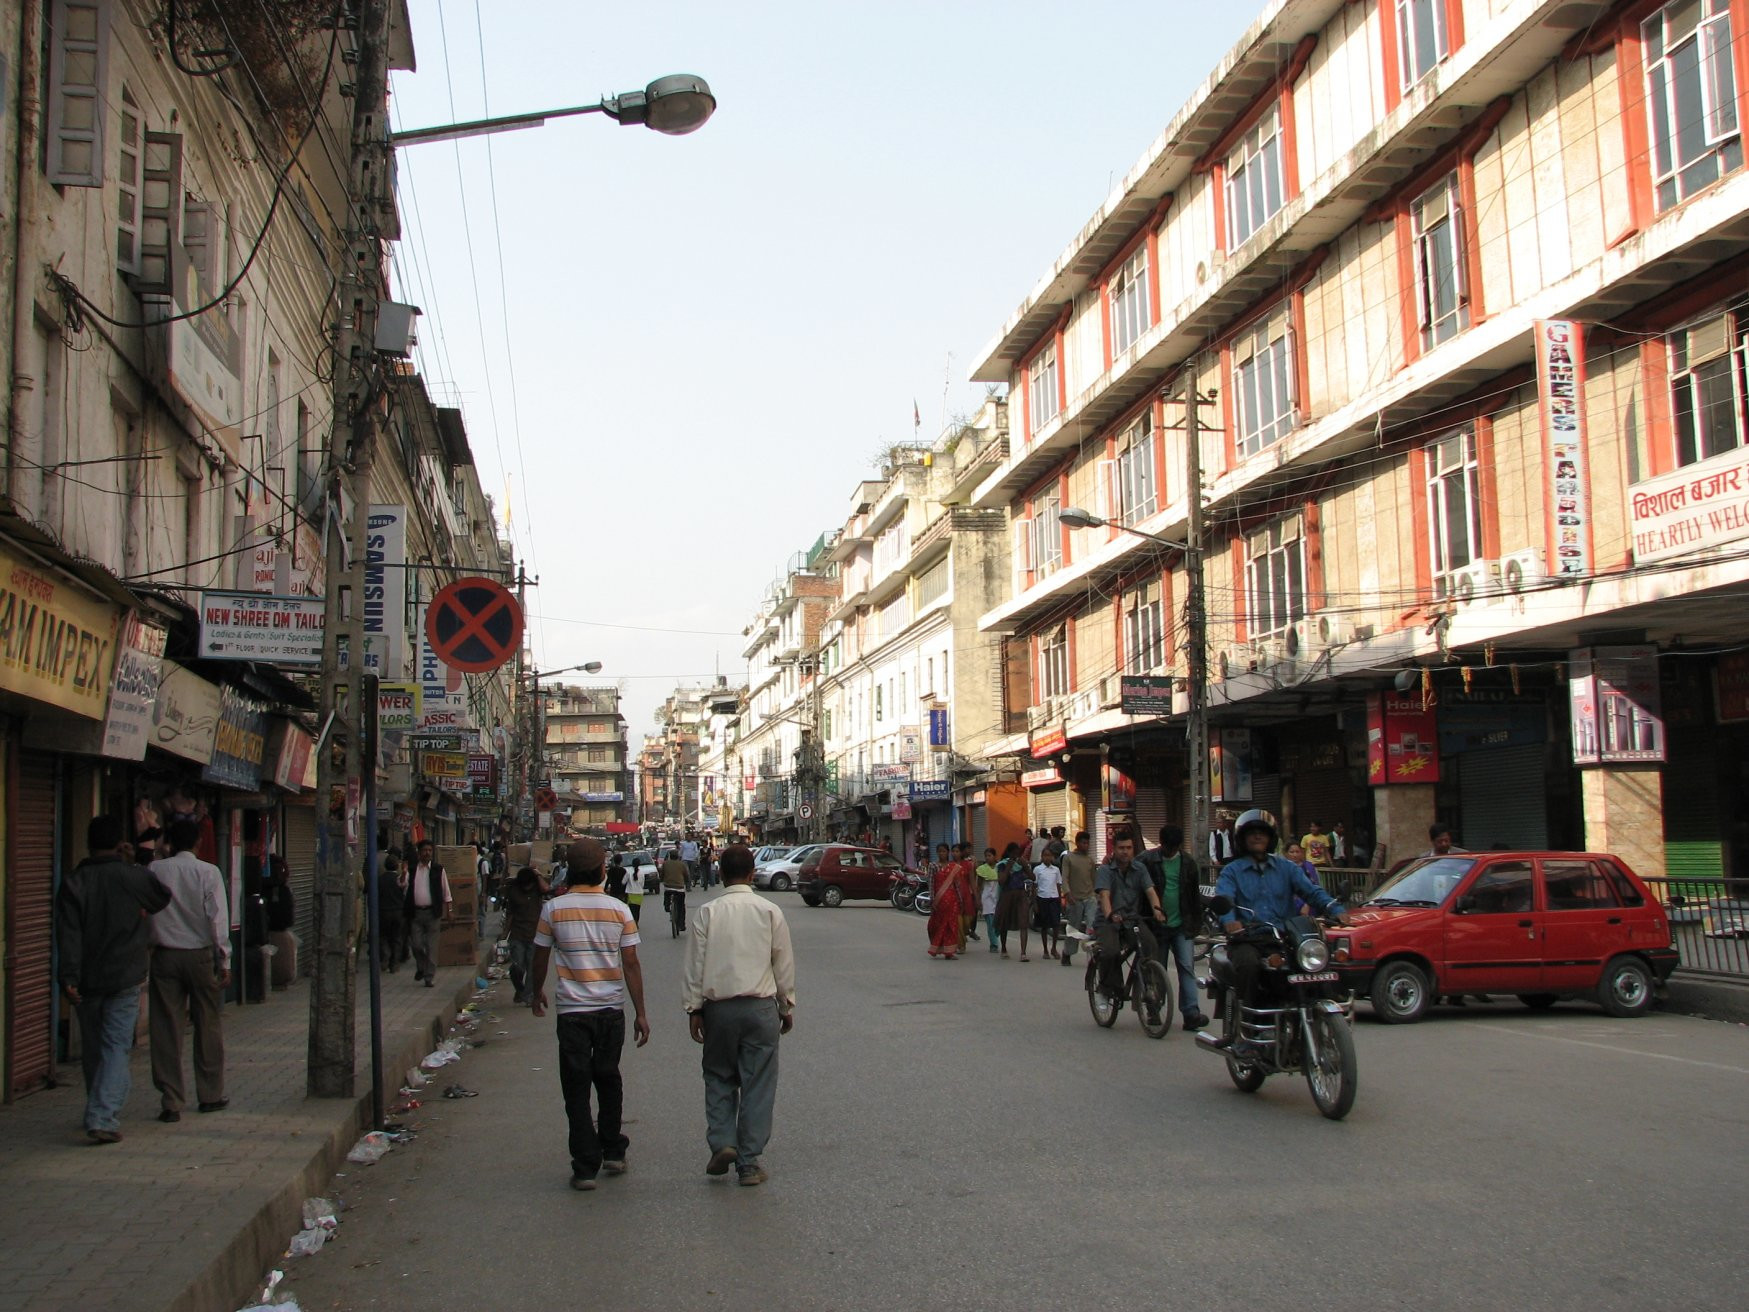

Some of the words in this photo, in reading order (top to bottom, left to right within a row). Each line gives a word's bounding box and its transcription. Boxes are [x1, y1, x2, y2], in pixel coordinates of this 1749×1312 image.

[1546, 324, 1576, 431] GAMERS
[1633, 485, 1686, 521] विशाल
[1690, 466, 1742, 501] बजार
[1636, 515, 1703, 556] HEARTLY
[206, 608, 230, 625] NEW
[233, 610, 270, 628] SHREE
[273, 611, 290, 629] OM
[244, 630, 265, 639] Gents
[36, 609, 108, 692] IMPEX
[282, 646, 309, 655] SERVICE
[1387, 700, 1429, 710] Haie
[427, 726, 457, 735] TAILORS
[414, 739, 430, 749] TIP
[430, 739, 449, 749] TOP
[914, 782, 946, 792] Haier
